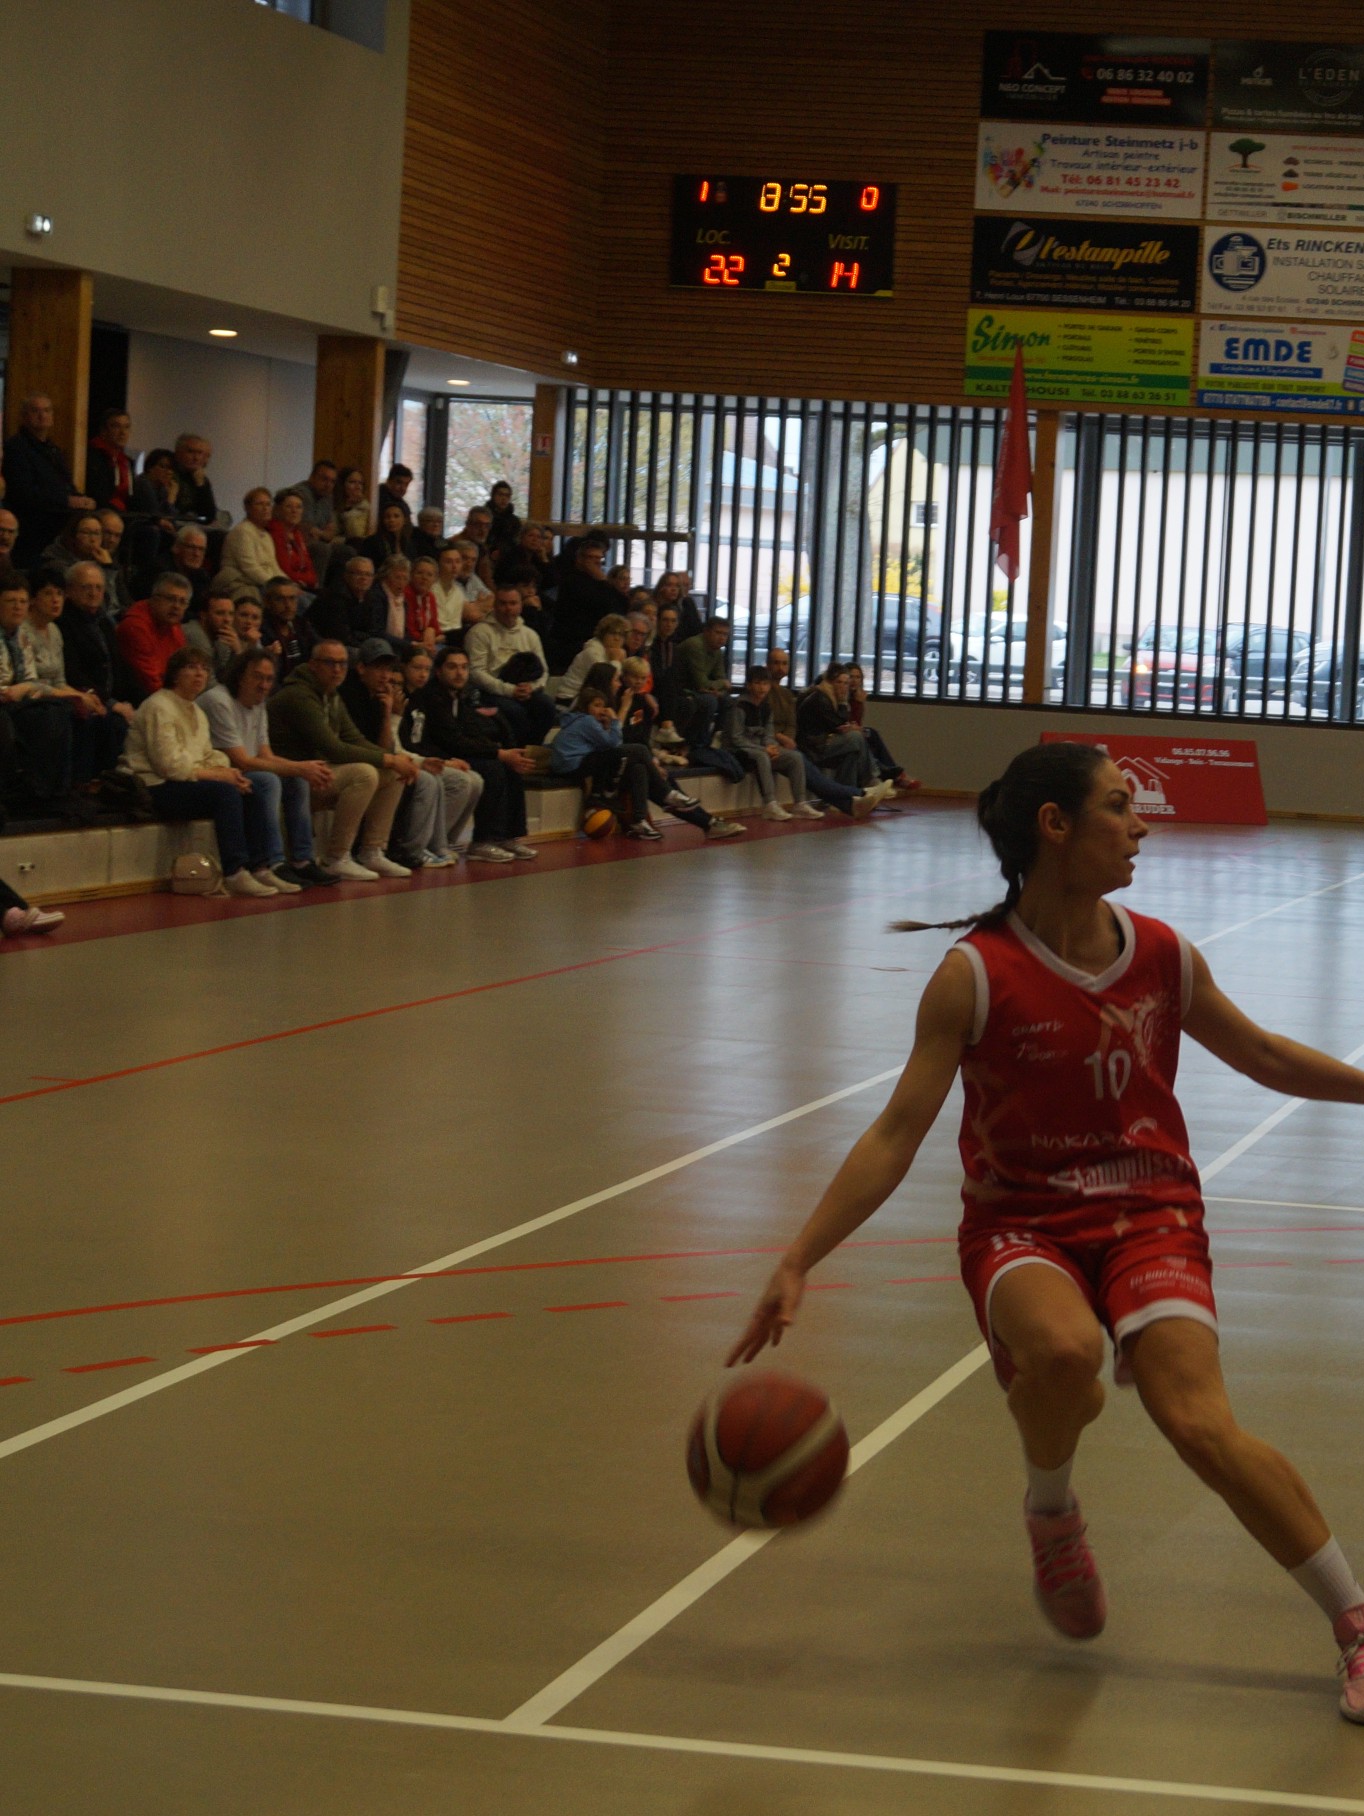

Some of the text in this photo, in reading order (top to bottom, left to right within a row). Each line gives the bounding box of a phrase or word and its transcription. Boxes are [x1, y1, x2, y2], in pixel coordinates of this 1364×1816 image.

[1096, 68, 1114, 81] 06
[1137, 69, 1154, 82] 32
[1157, 71, 1174, 83] 40
[1177, 71, 1194, 84] 02
[1299, 67, 1360, 81] L'EDEN
[1021, 84, 1066, 94] CONCEPT
[1042, 133, 1099, 147] Peinture
[1105, 135, 1174, 149] Steinmetz
[1086, 175, 1180, 188] 06 81 45 23 42
[700, 181, 709, 202] 1
[861, 187, 879, 211] 0
[1267, 238, 1290, 251] Ets
[1039, 235, 1171, 271] l'estampille
[703, 254, 745, 285] 22
[773, 253, 791, 277] 2
[1272, 256, 1353, 270] INSTALLATION
[971, 315, 1051, 353] Simon
[976, 384, 1070, 396] KALTHOUSE
[1101, 389, 1113, 398] 03
[1083, 1049, 1132, 1101] 10
